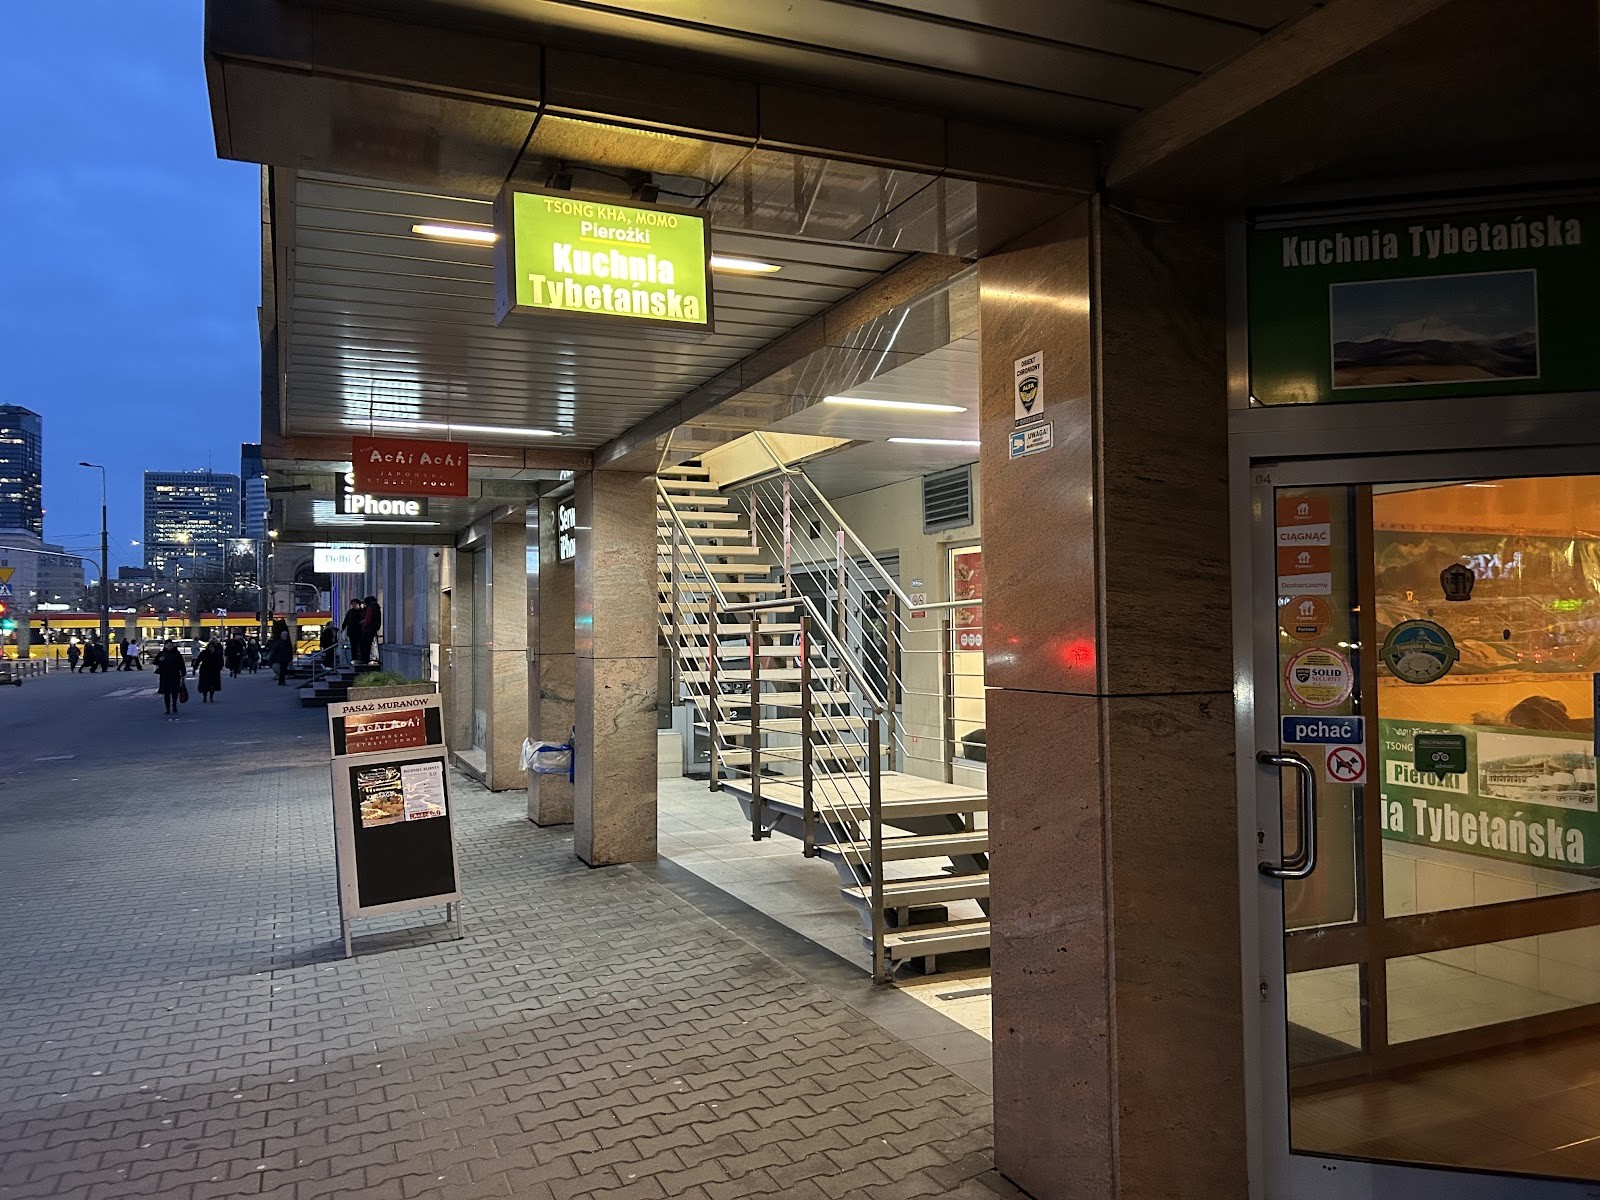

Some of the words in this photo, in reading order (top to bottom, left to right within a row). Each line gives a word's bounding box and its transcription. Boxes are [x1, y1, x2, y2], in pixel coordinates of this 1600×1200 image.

[544, 199, 594, 217] TSONG
[597, 206, 631, 225] KHA,
[635, 212, 678, 228] MOMO
[580, 221, 650, 244] Pierożki
[1282, 229, 1399, 268] Kuchnia
[1408, 215, 1582, 259] Tybetańska
[553, 242, 675, 285] Kuchnia
[529, 273, 700, 320] Tybetańska
[1022, 382, 1035, 392] ALFA
[369, 449, 413, 464] Achi
[419, 452, 463, 467] Achi
[1255, 473, 1272, 485] 04
[344, 494, 420, 515] iPhone
[1280, 531, 1327, 542] CIĄGNĄĆ
[325, 555, 351, 564] Delhi
[342, 702, 375, 714] PASAŻ
[377, 698, 429, 710] MURANÓW
[1295, 722, 1352, 740] pchać
[356, 740, 388, 748] STREET
[394, 736, 418, 744] FOOD
[1386, 741, 1414, 752] TSONG
[1413, 798, 1585, 864] Tybetańska
